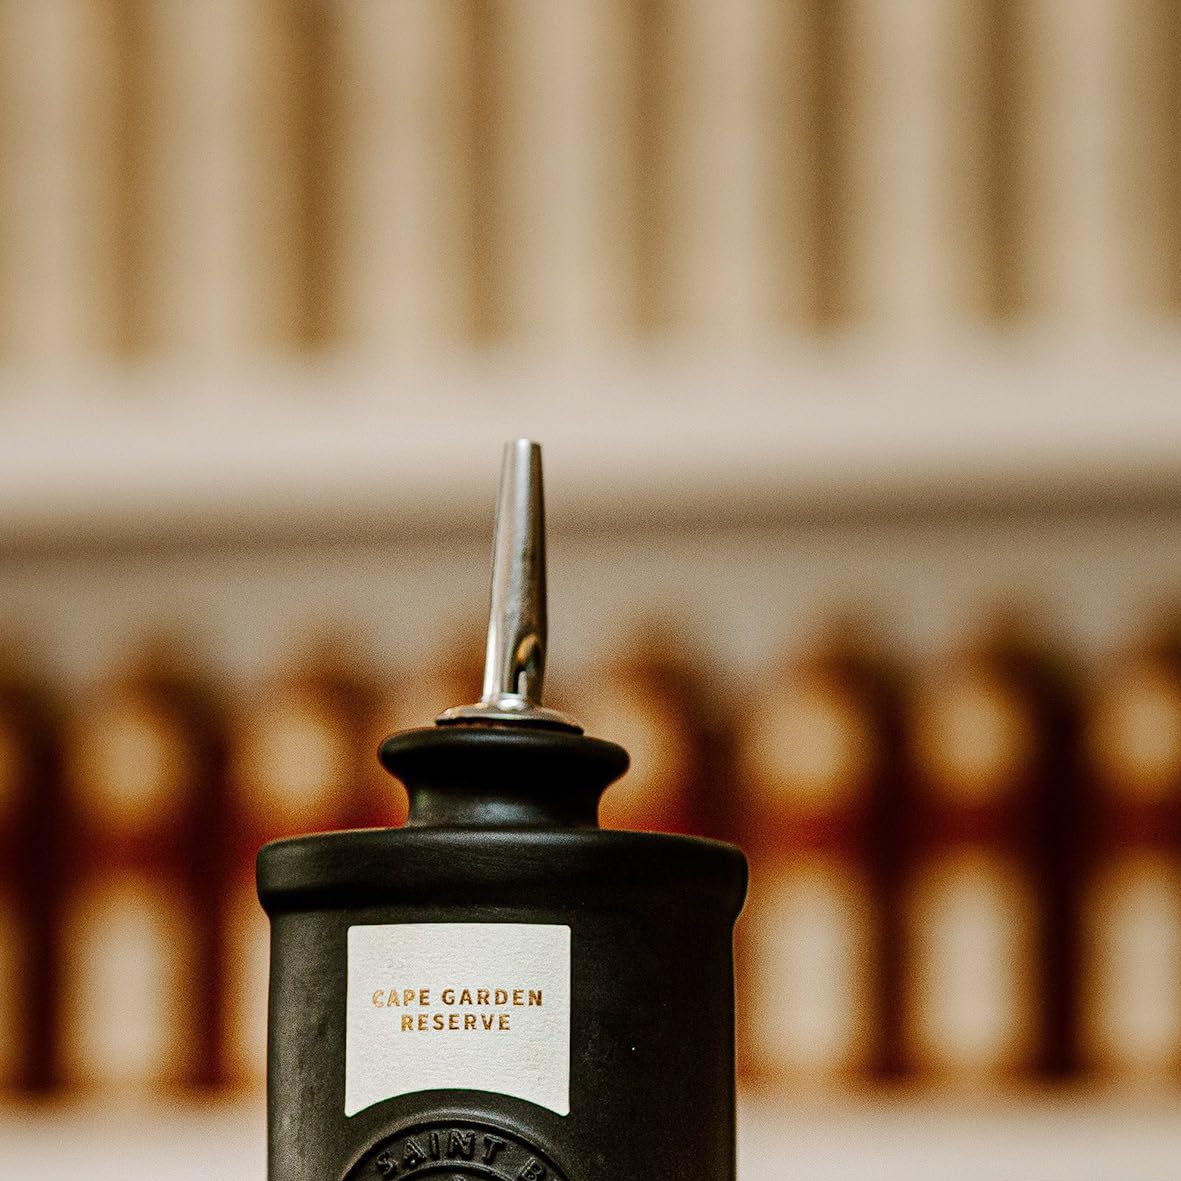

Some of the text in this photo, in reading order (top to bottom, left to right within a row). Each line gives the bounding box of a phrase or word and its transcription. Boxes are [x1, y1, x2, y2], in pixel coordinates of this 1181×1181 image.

[373, 988, 543, 1007] CAPE GARDEN
[401, 1013, 511, 1031] RESERVE
[375, 1129, 506, 1178] SAINT
